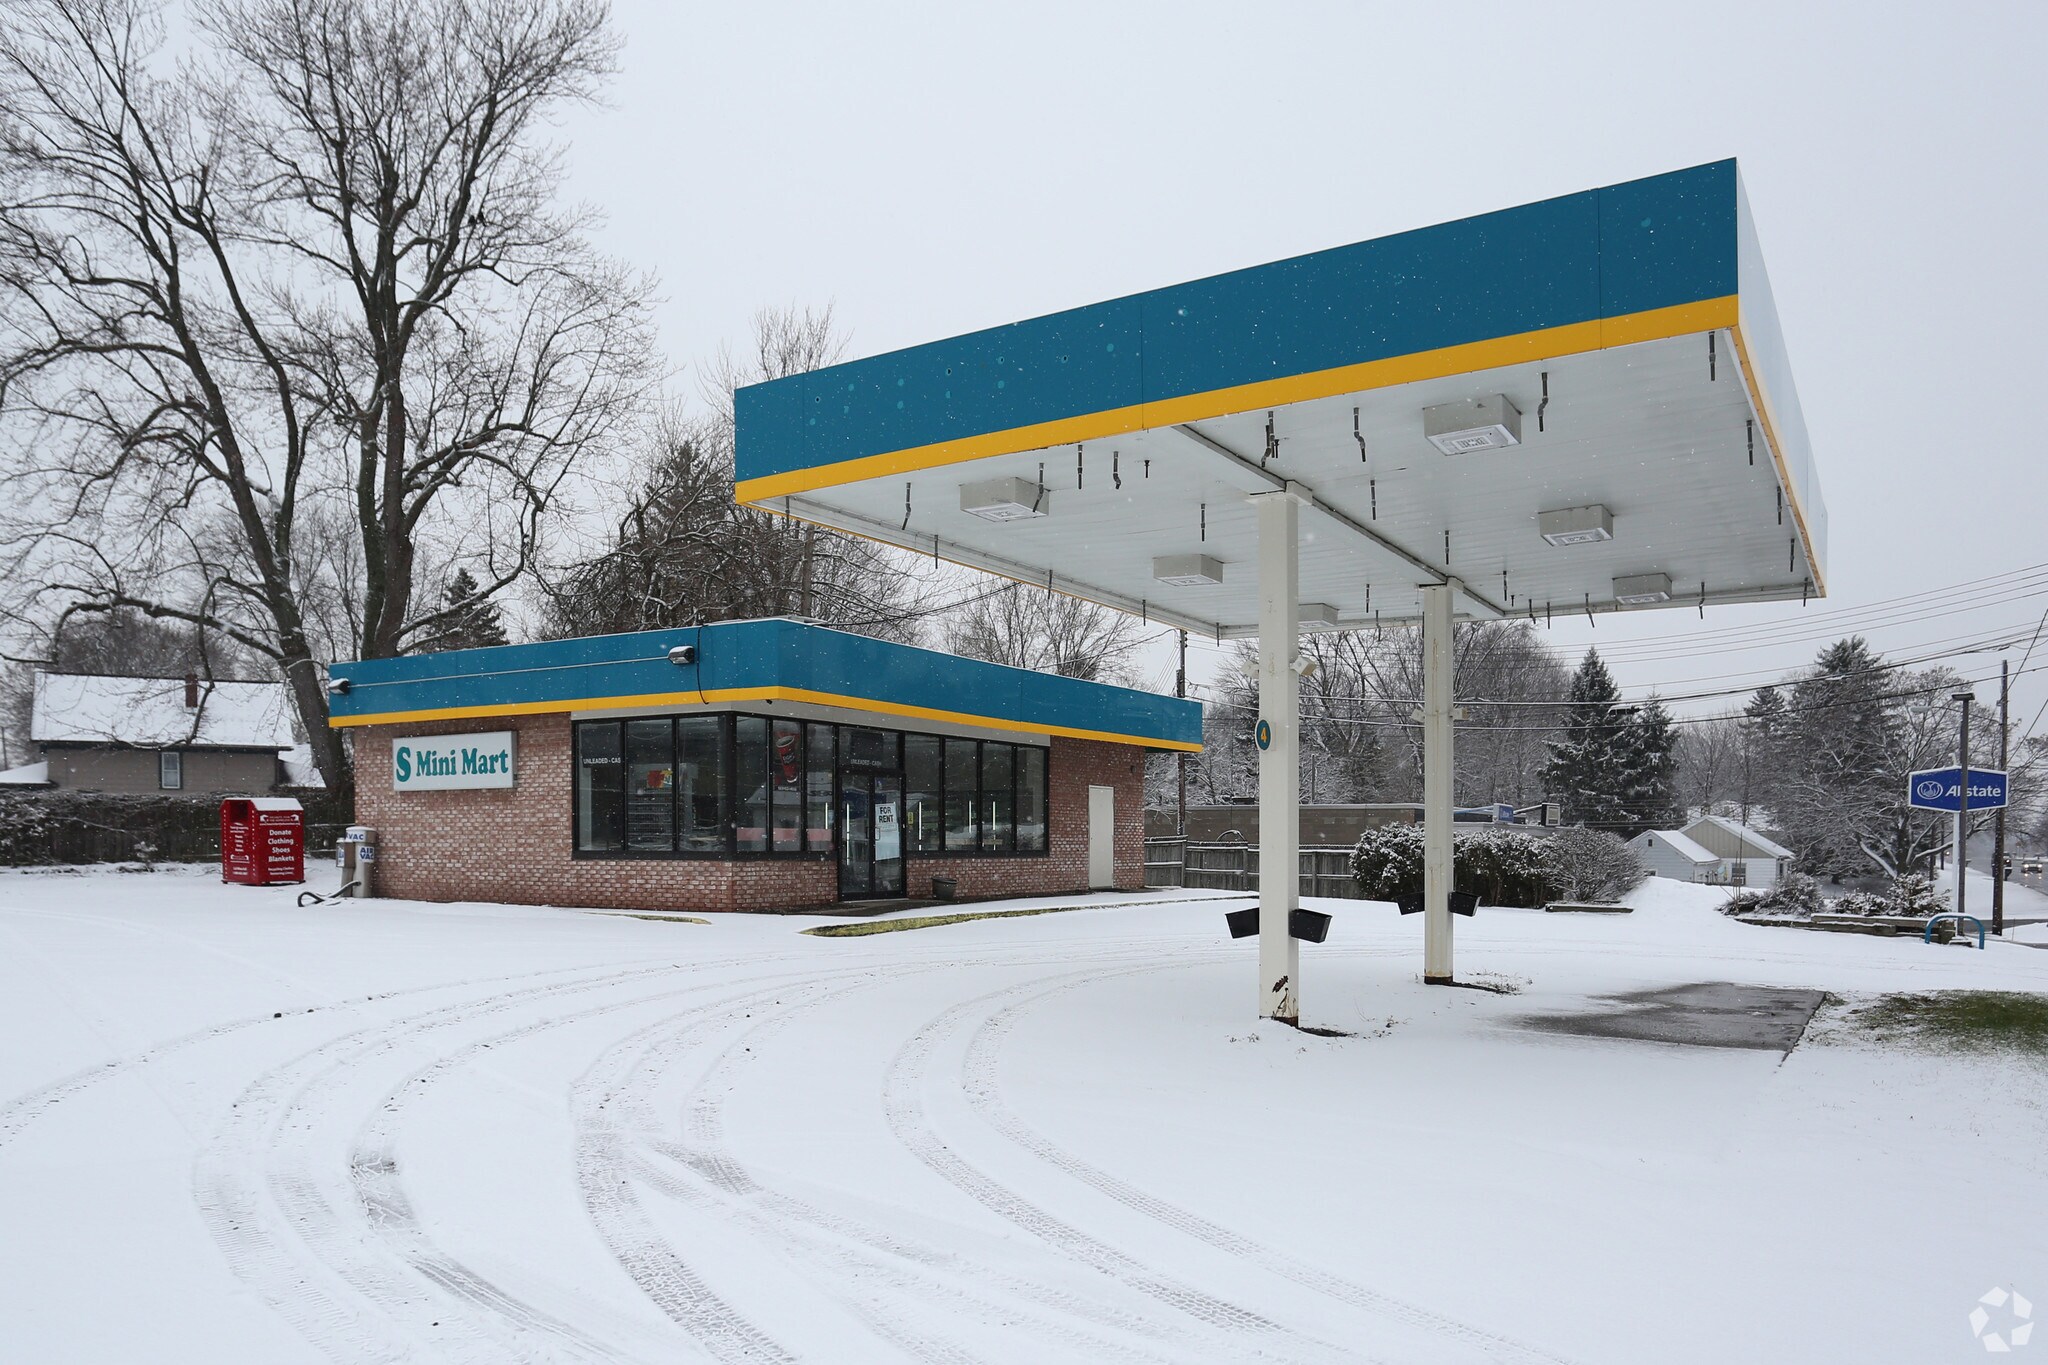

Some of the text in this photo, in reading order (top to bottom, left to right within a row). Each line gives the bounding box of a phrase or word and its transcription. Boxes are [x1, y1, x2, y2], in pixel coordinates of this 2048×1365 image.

[1261, 727, 1267, 743] 4
[396, 747, 508, 782] S Mini Mart
[1945, 785, 2001, 796] Alstate
